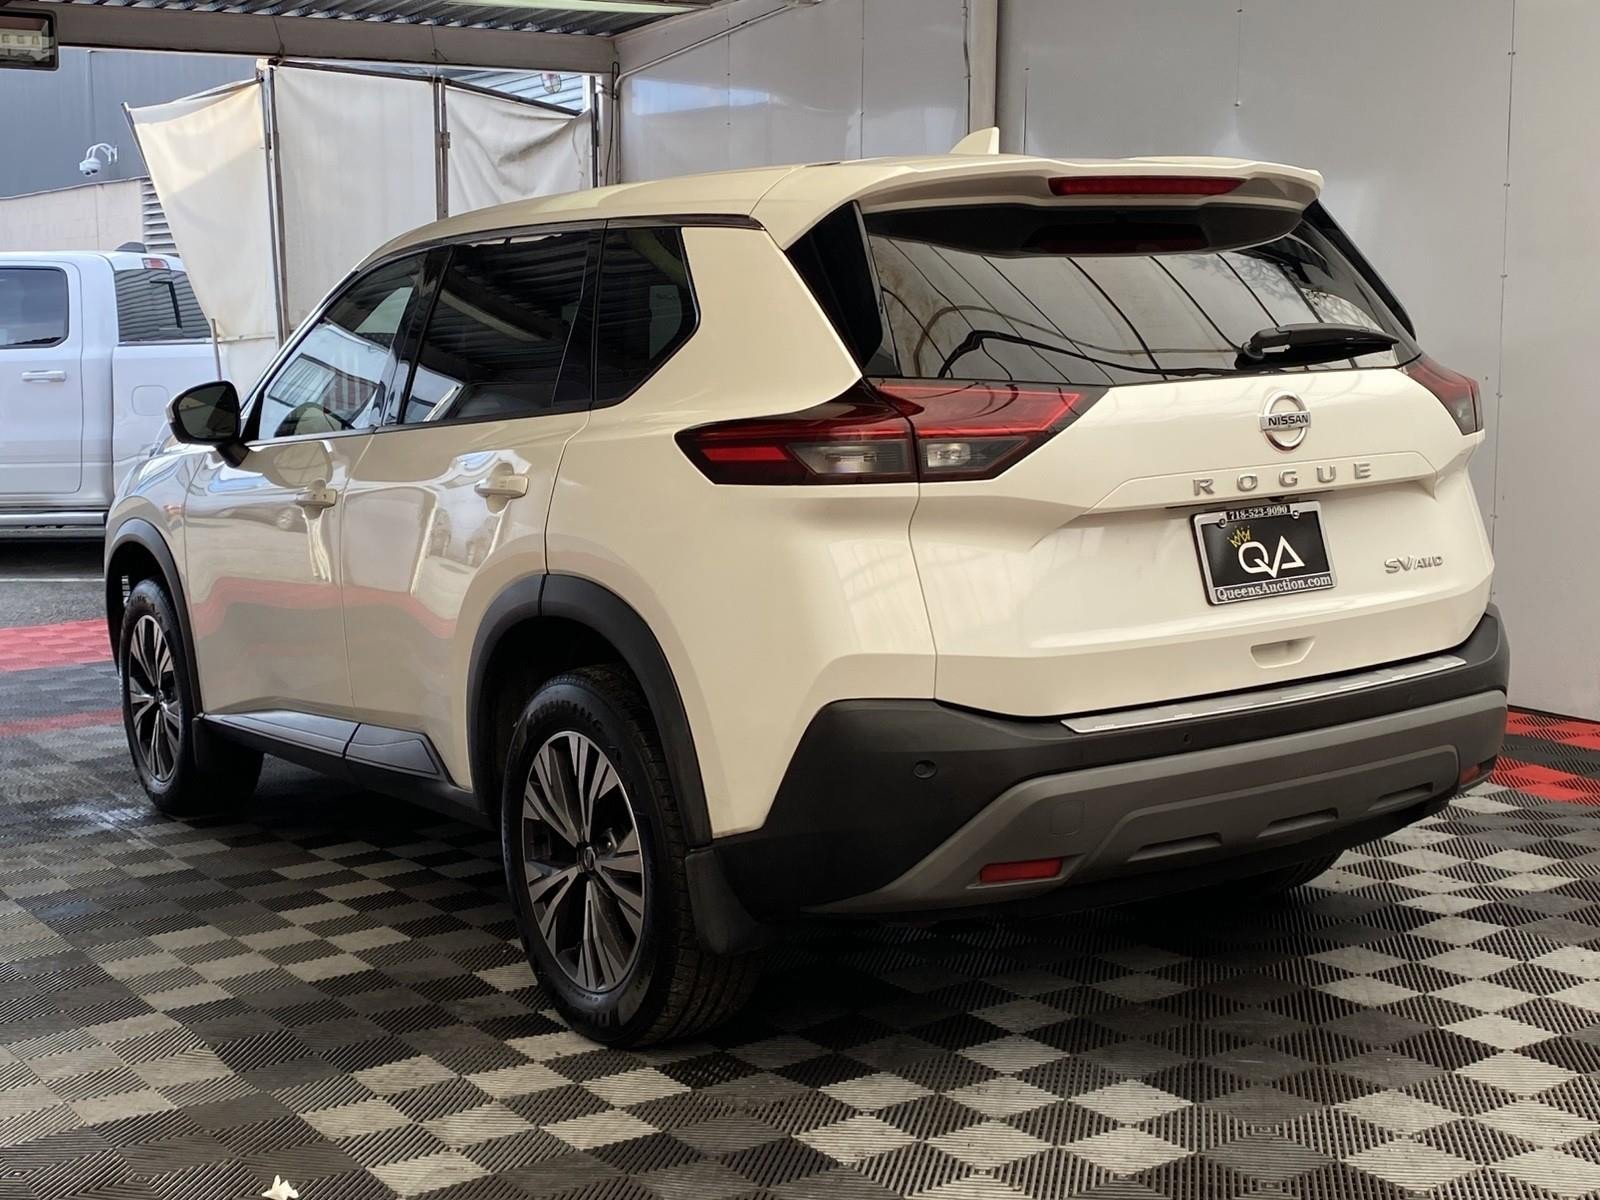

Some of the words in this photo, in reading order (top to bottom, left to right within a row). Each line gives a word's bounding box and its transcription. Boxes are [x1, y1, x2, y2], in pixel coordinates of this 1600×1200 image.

[1267, 413, 1309, 427] NISSAN
[1192, 462, 1372, 496] ROGUE
[1229, 505, 1288, 520] 718-523-9090
[1384, 556, 1413, 574] SV
[1216, 575, 1333, 601] QueensAuction.com
